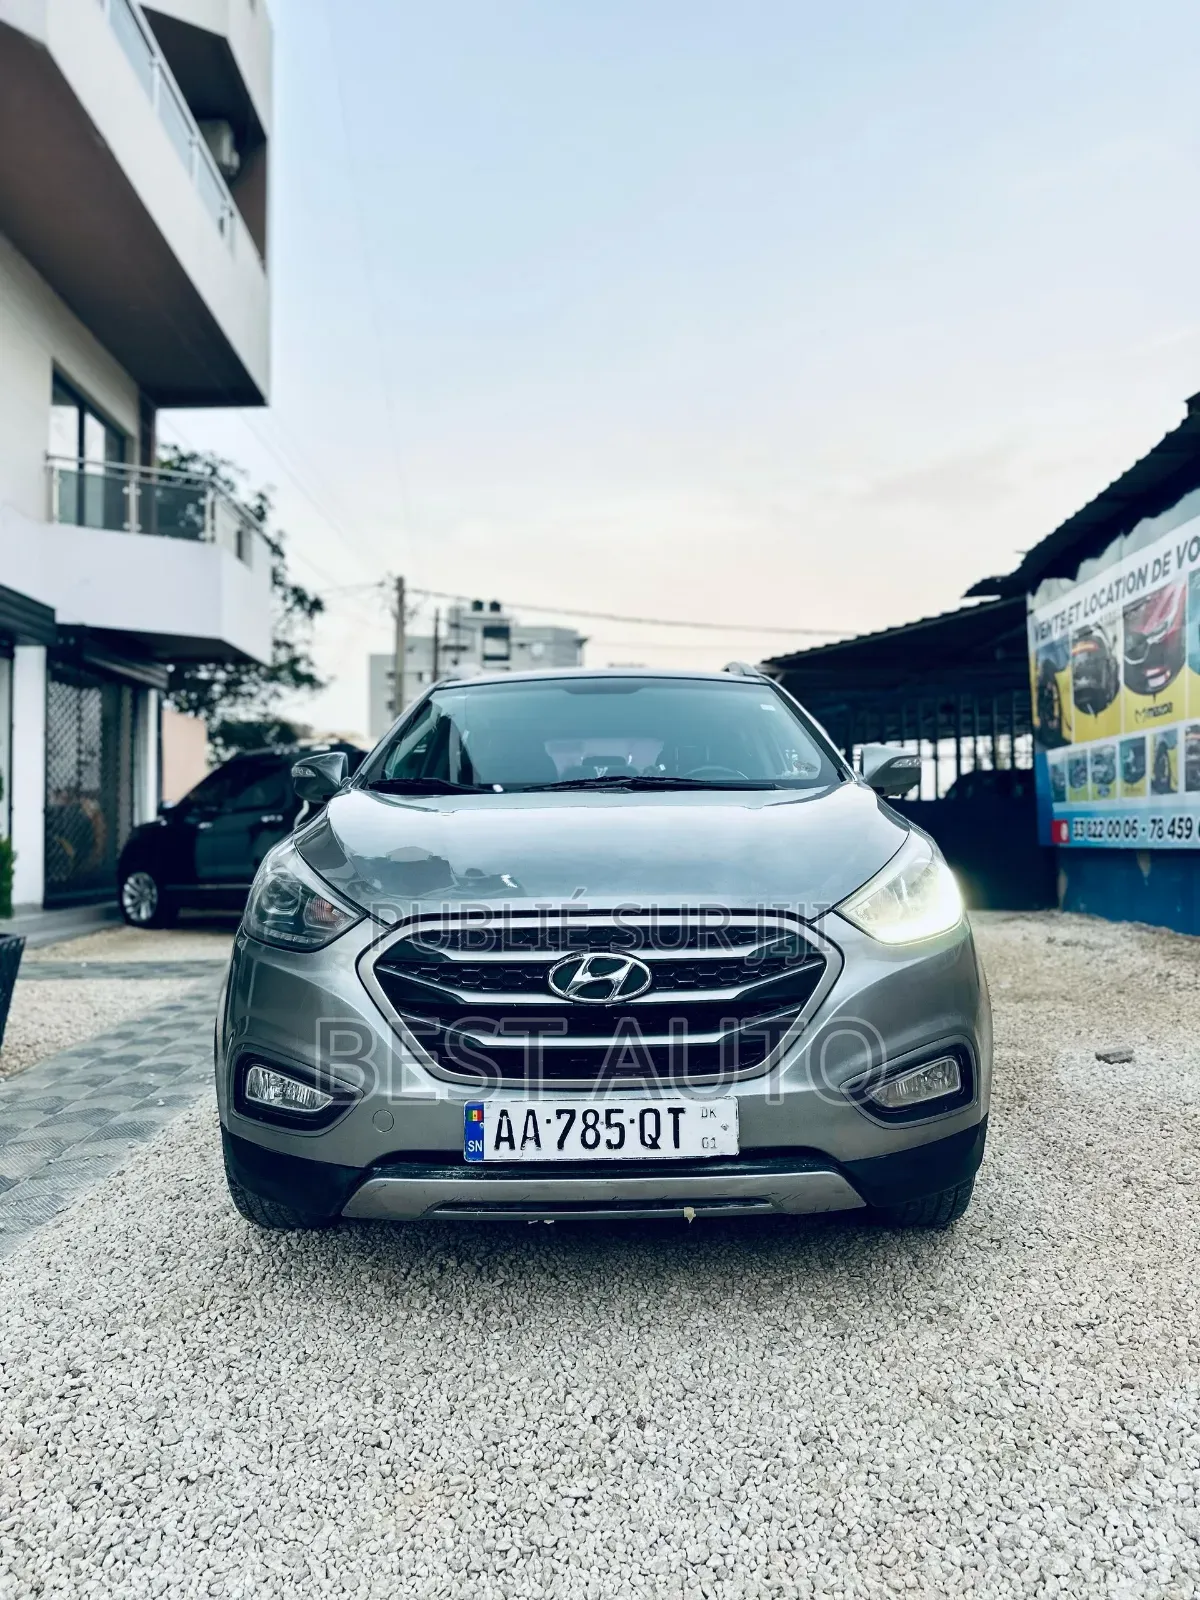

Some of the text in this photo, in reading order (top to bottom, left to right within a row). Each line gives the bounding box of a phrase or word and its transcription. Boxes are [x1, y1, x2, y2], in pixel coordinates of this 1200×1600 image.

[1068, 601, 1082, 625] ET
[1083, 563, 1148, 618] LOCATION
[1151, 550, 1171, 584] DE
[1107, 820, 1121, 838] 00
[1150, 818, 1164, 839] 78
[1167, 816, 1193, 839] 459
[700, 1106, 717, 1118] DK
[468, 1140, 483, 1152] SN
